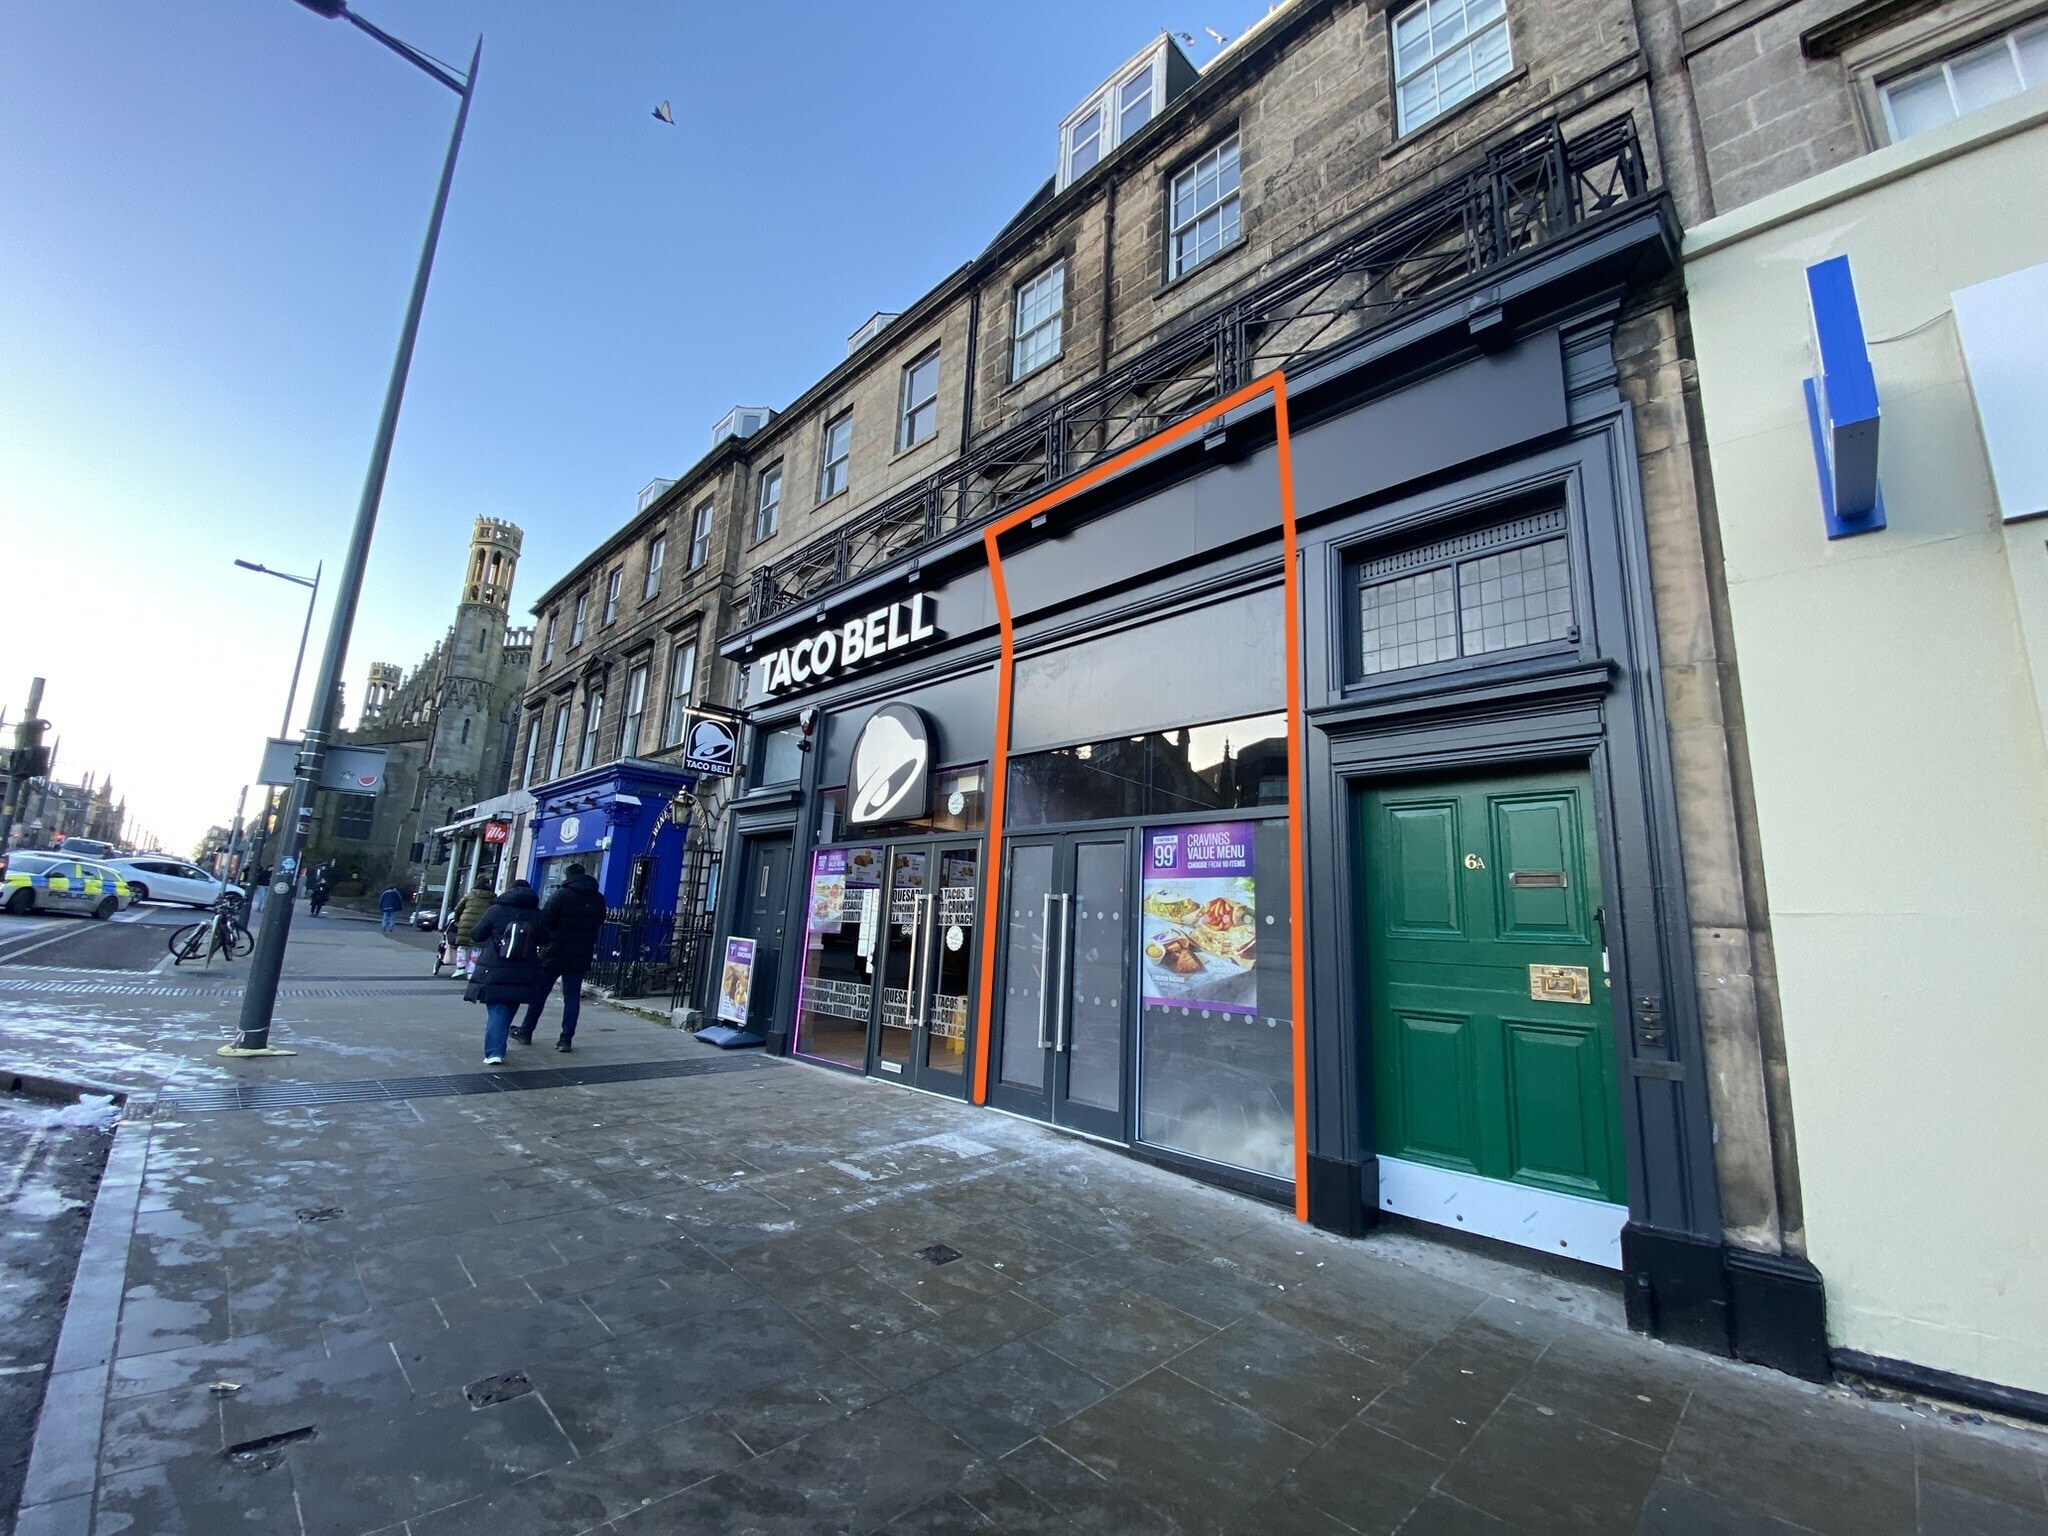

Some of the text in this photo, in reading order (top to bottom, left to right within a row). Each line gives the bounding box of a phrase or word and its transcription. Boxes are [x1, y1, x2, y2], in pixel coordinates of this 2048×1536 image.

[758, 592, 934, 694] TACO BELL
[686, 759, 733, 775] TACO BELL
[487, 826, 506, 841] illy
[1187, 832, 1230, 846] CRAVINGS
[1187, 844, 1245, 860] VALUE MENU
[1187, 861, 1208, 869] CHOOSE
[1208, 861, 1222, 869] FROM
[1229, 859, 1246, 868] ITEMS
[1464, 853, 1486, 870] 6A
[49, 890, 97, 901] POLICE
[944, 888, 966, 900] TACOS
[834, 981, 857, 996] NACHOS
[937, 996, 958, 1010] TACOS
